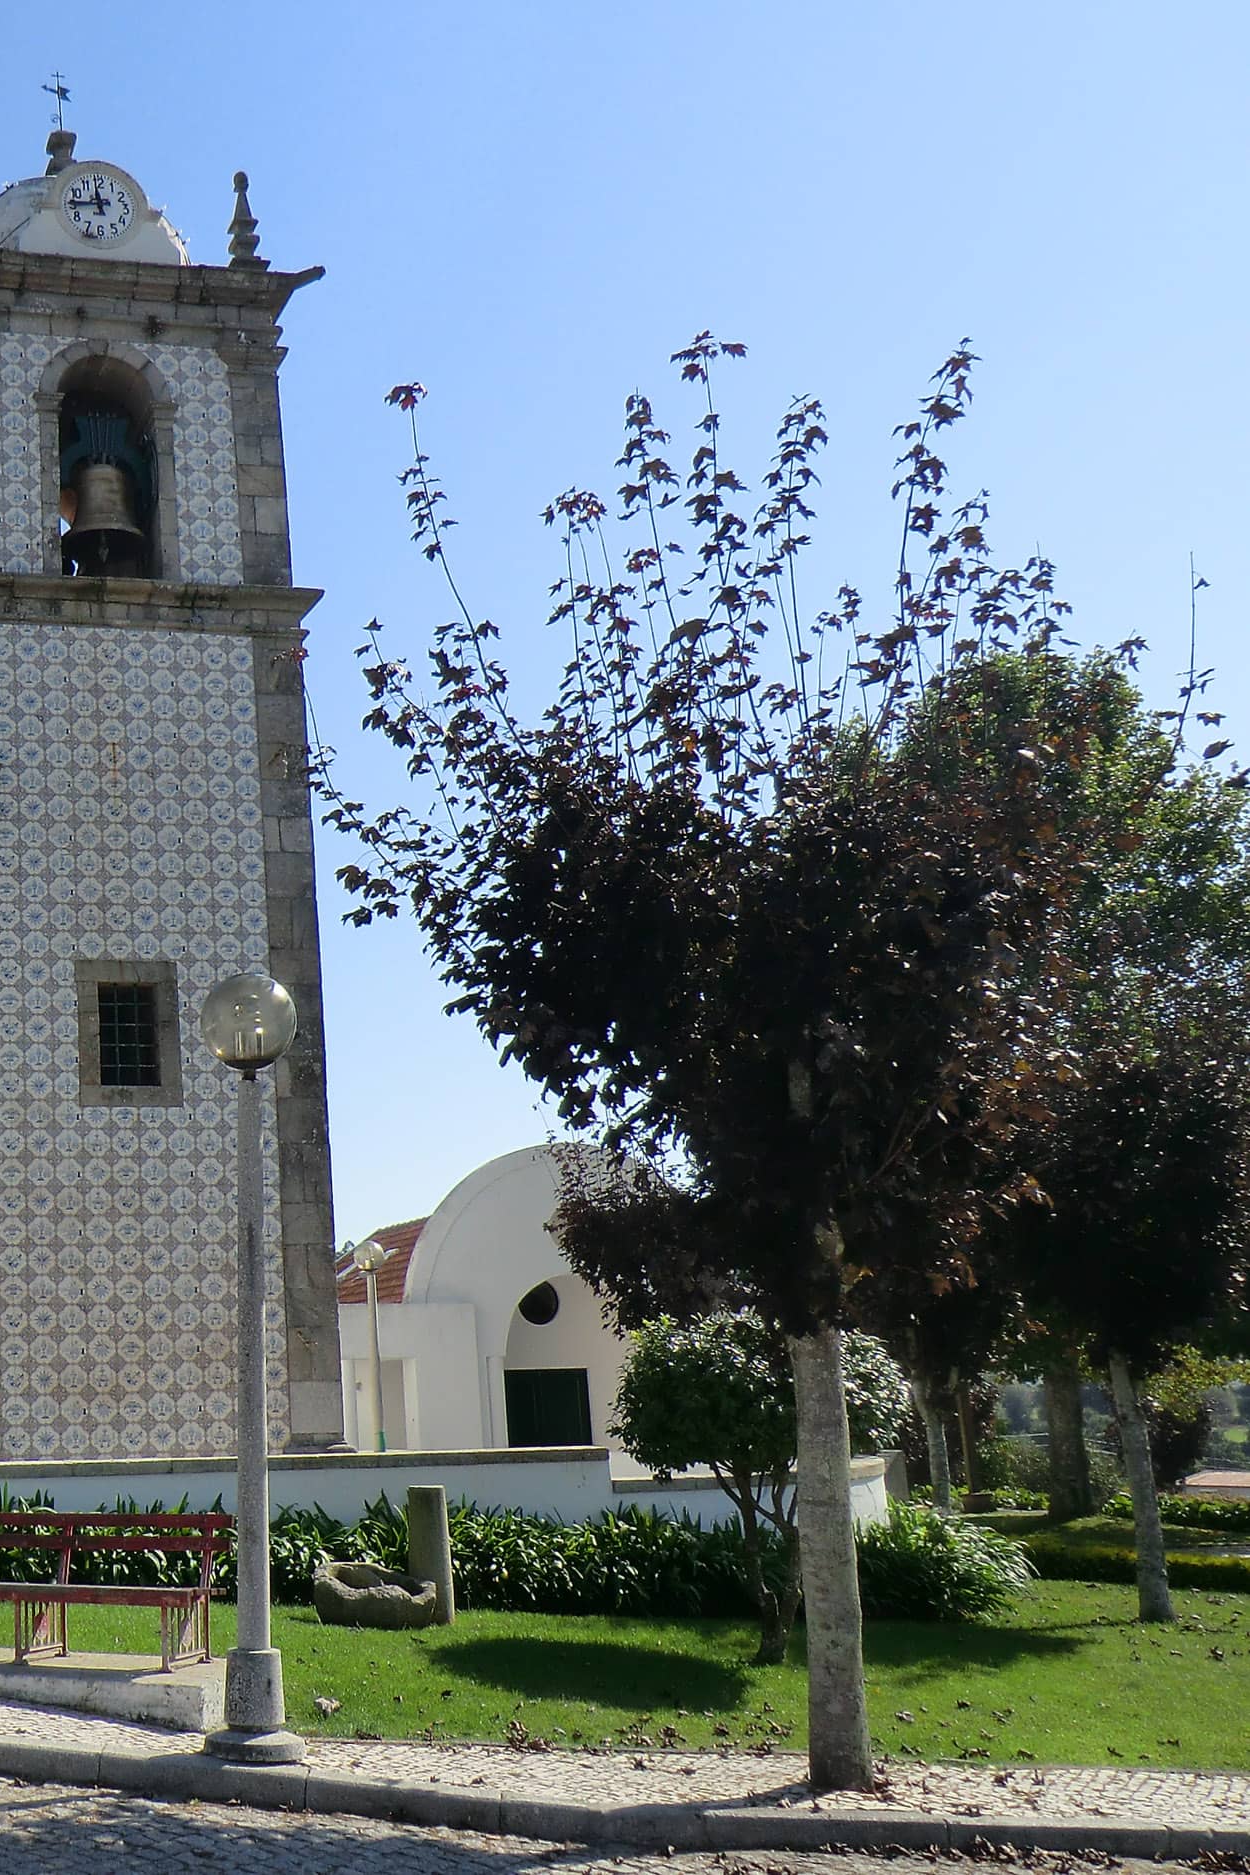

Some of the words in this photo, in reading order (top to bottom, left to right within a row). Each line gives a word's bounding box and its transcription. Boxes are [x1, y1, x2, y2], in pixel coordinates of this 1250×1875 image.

[82, 180, 89, 190] 11
[93, 178, 104, 189] 2
[110, 182, 114, 192] 1
[71, 188, 81, 199] 10
[118, 192, 125, 202] 2
[123, 204, 129, 215] 3
[74, 211, 81, 222] 8
[118, 216, 125, 226] 4
[85, 221, 92, 233] 7
[97, 225, 104, 236] 6
[110, 224, 118, 234] 5
